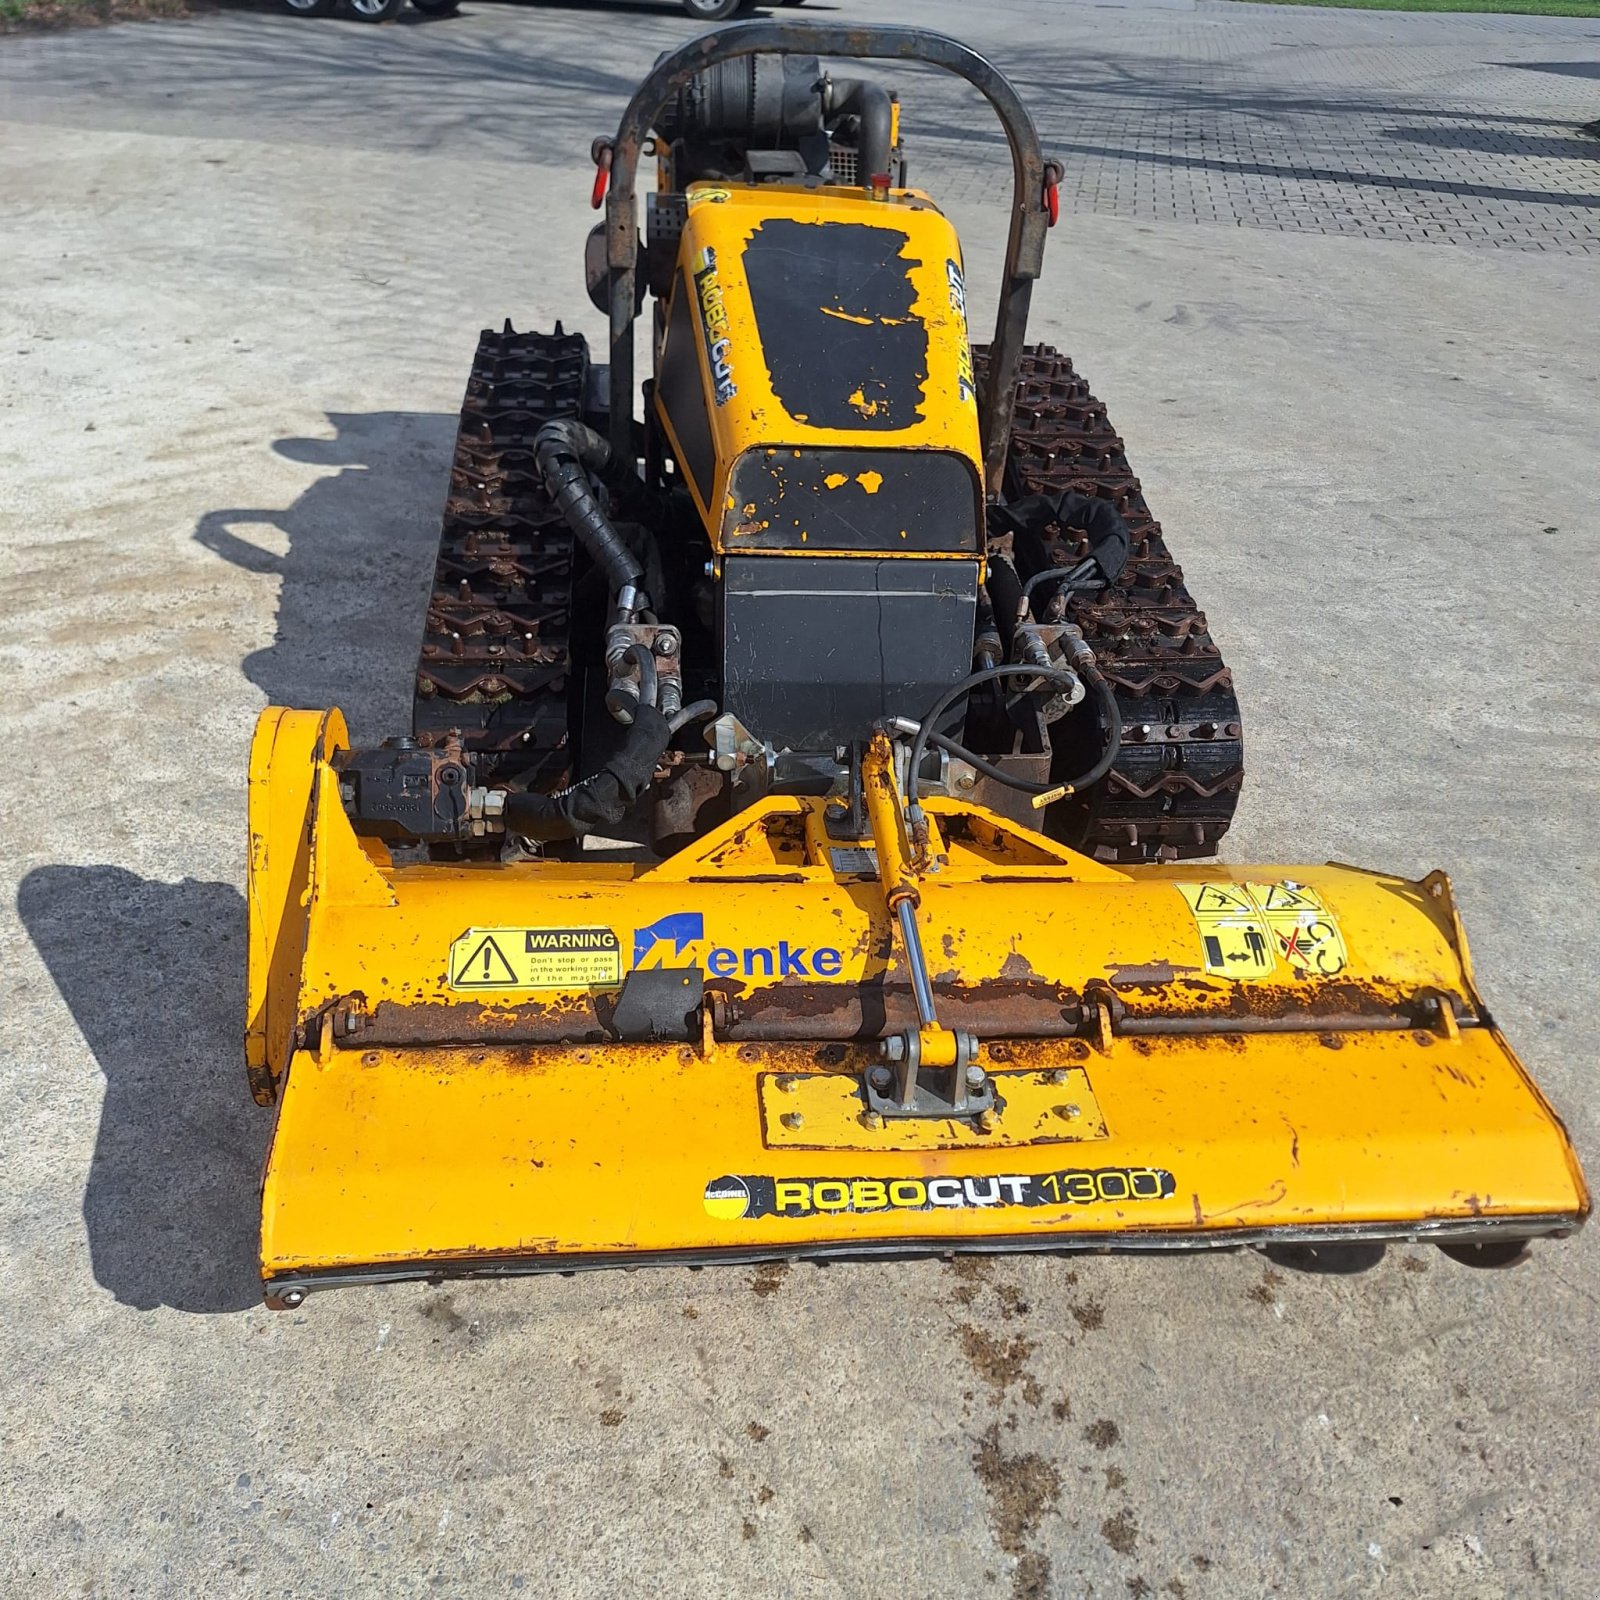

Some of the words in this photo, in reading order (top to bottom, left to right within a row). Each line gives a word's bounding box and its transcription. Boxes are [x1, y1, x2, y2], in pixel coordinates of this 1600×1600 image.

[530, 933, 615, 949] WARNING
[557, 957, 576, 965] stop
[593, 957, 613, 965] pass
[555, 965, 588, 974] working
[590, 965, 613, 974] range
[775, 1176, 1032, 1211] ROBOCUT
[1041, 1171, 1163, 1202] 1300
